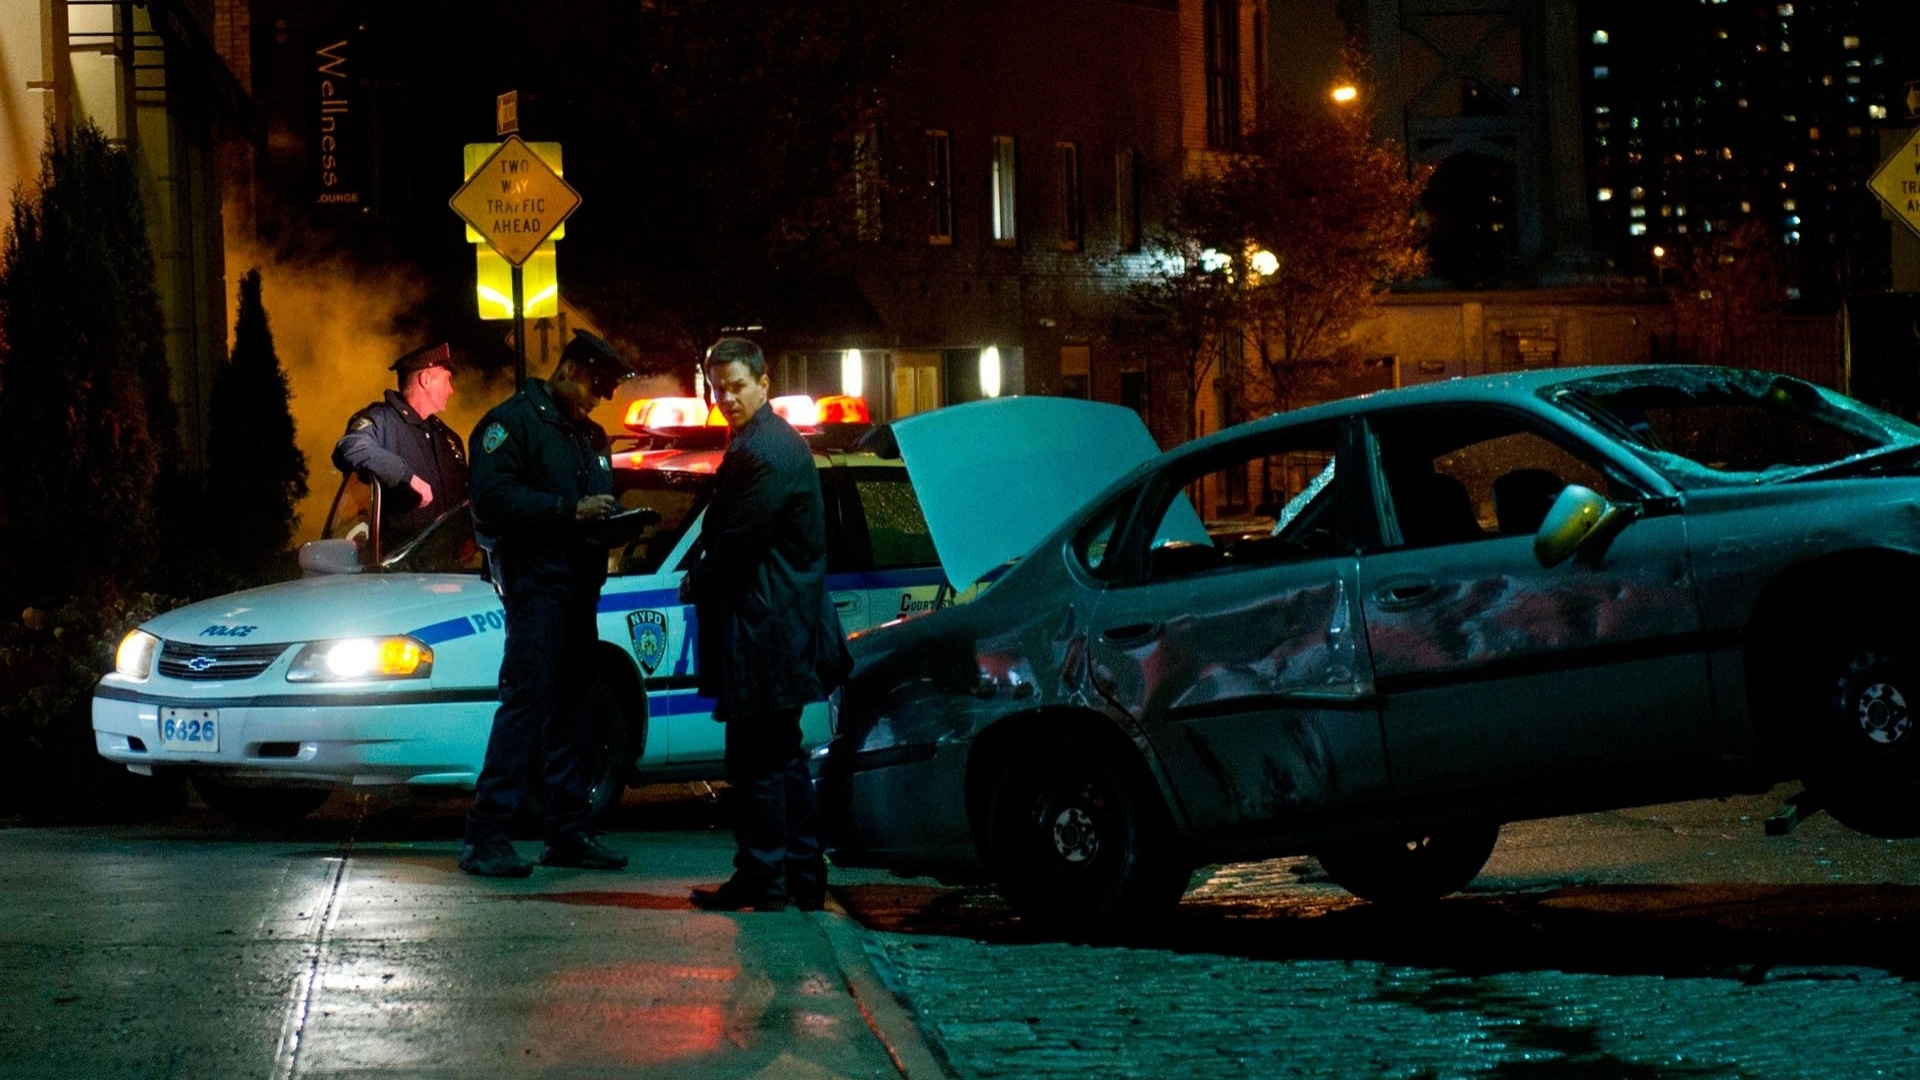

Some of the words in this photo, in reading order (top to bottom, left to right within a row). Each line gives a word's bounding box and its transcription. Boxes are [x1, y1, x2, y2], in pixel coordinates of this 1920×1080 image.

[316, 40, 349, 187] Wellness
[501, 160, 529, 173] TWO
[502, 180, 528, 194] WAY
[487, 199, 545, 214] TRAFFIC
[493, 219, 541, 233] AHEAD
[630, 612, 662, 625] NYPD
[200, 625, 258, 637] POLICE
